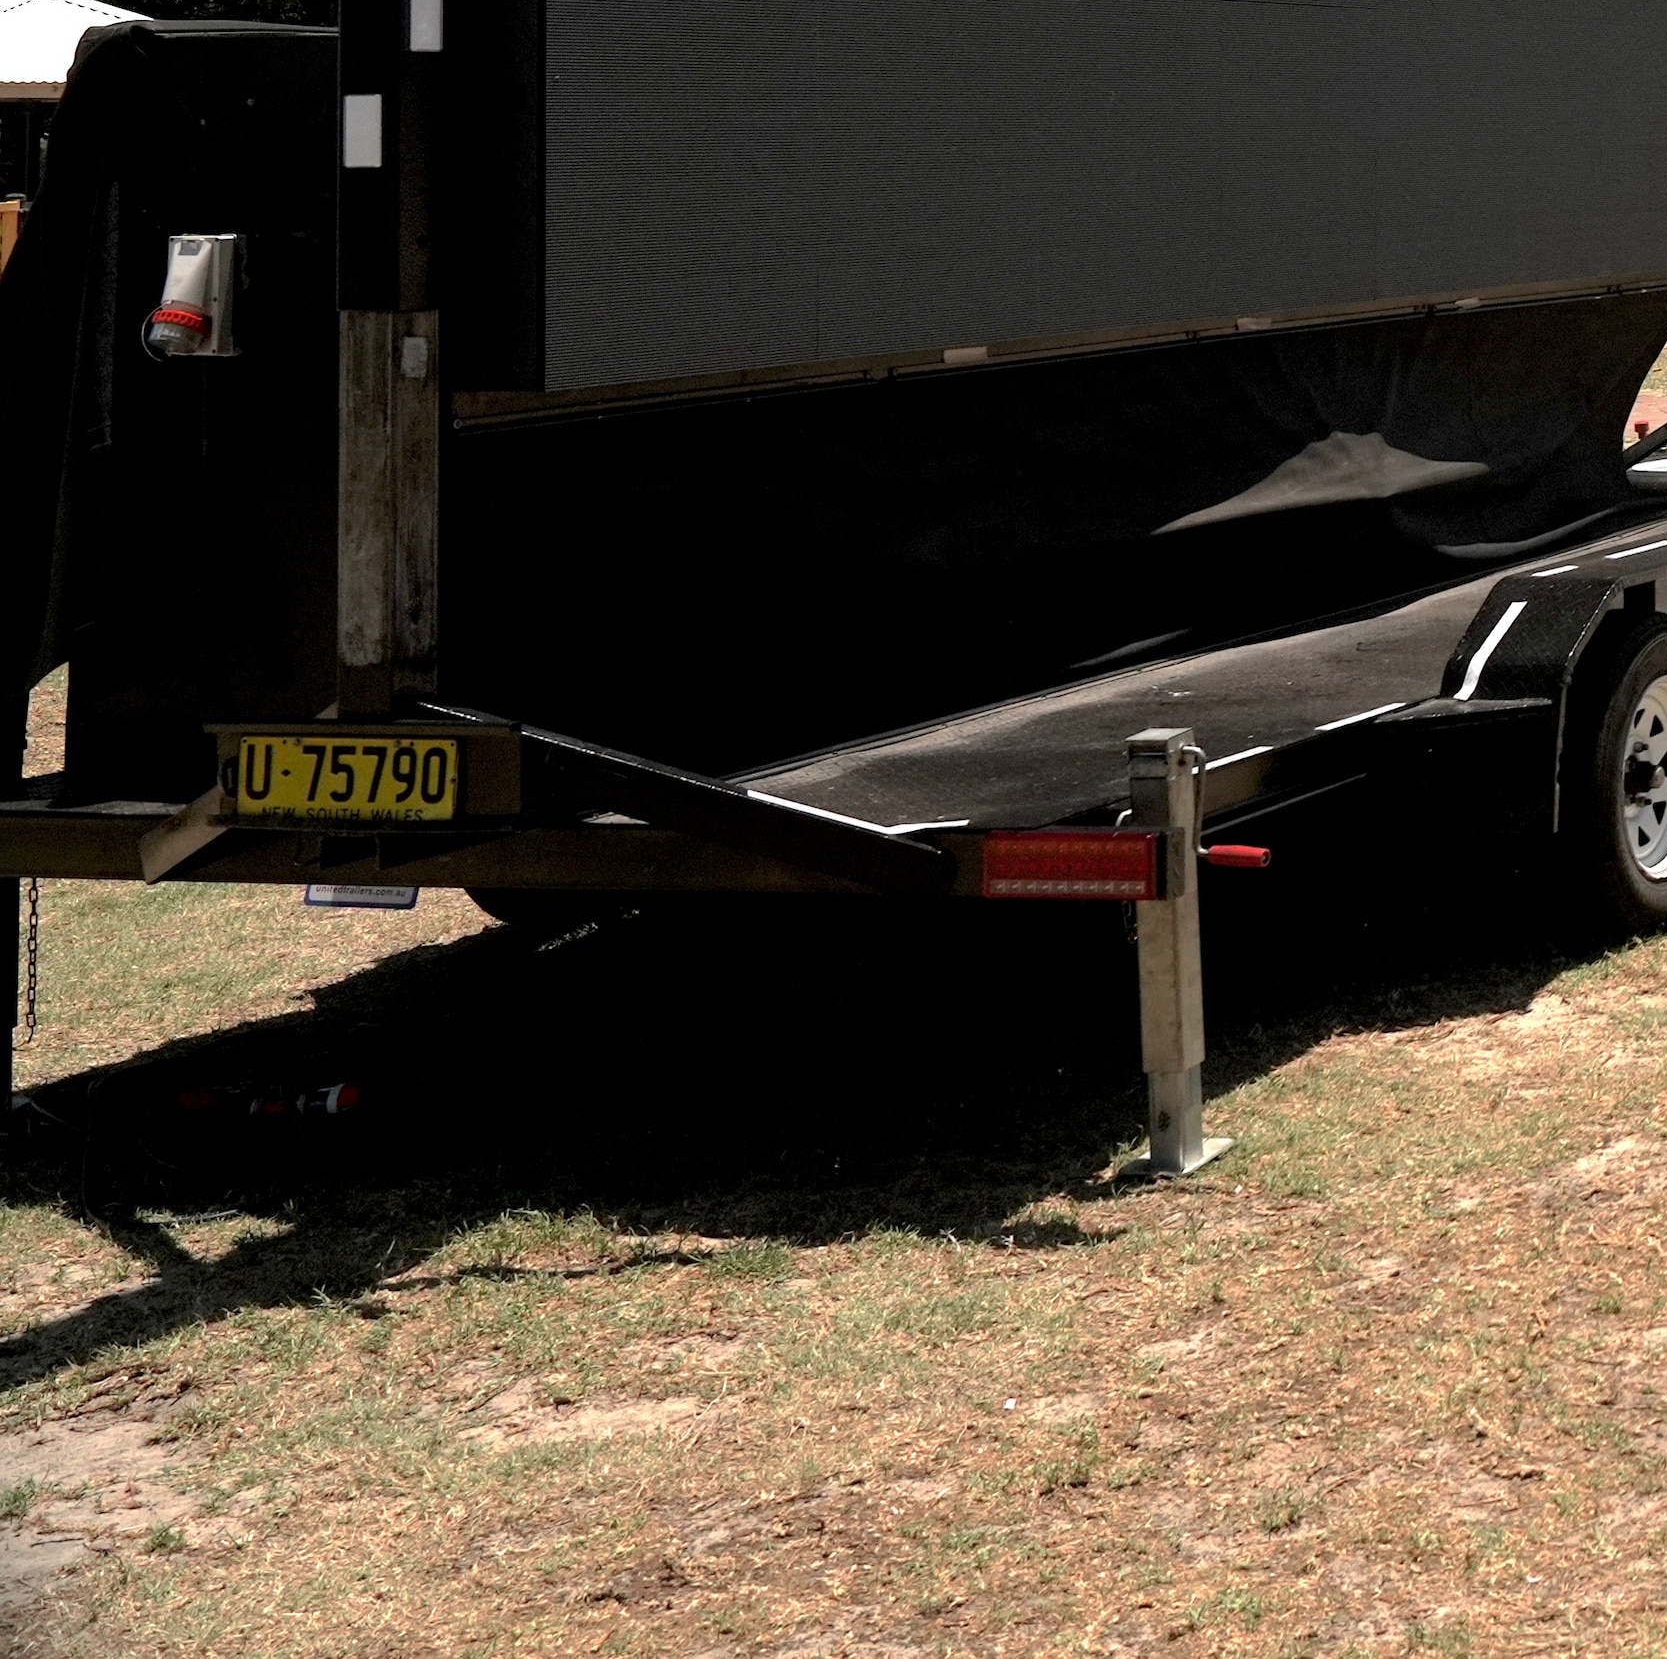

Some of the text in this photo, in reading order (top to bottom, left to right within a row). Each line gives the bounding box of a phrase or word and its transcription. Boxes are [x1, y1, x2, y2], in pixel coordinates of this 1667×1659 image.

[262, 806, 425, 822] NEW SOUTH WALES
